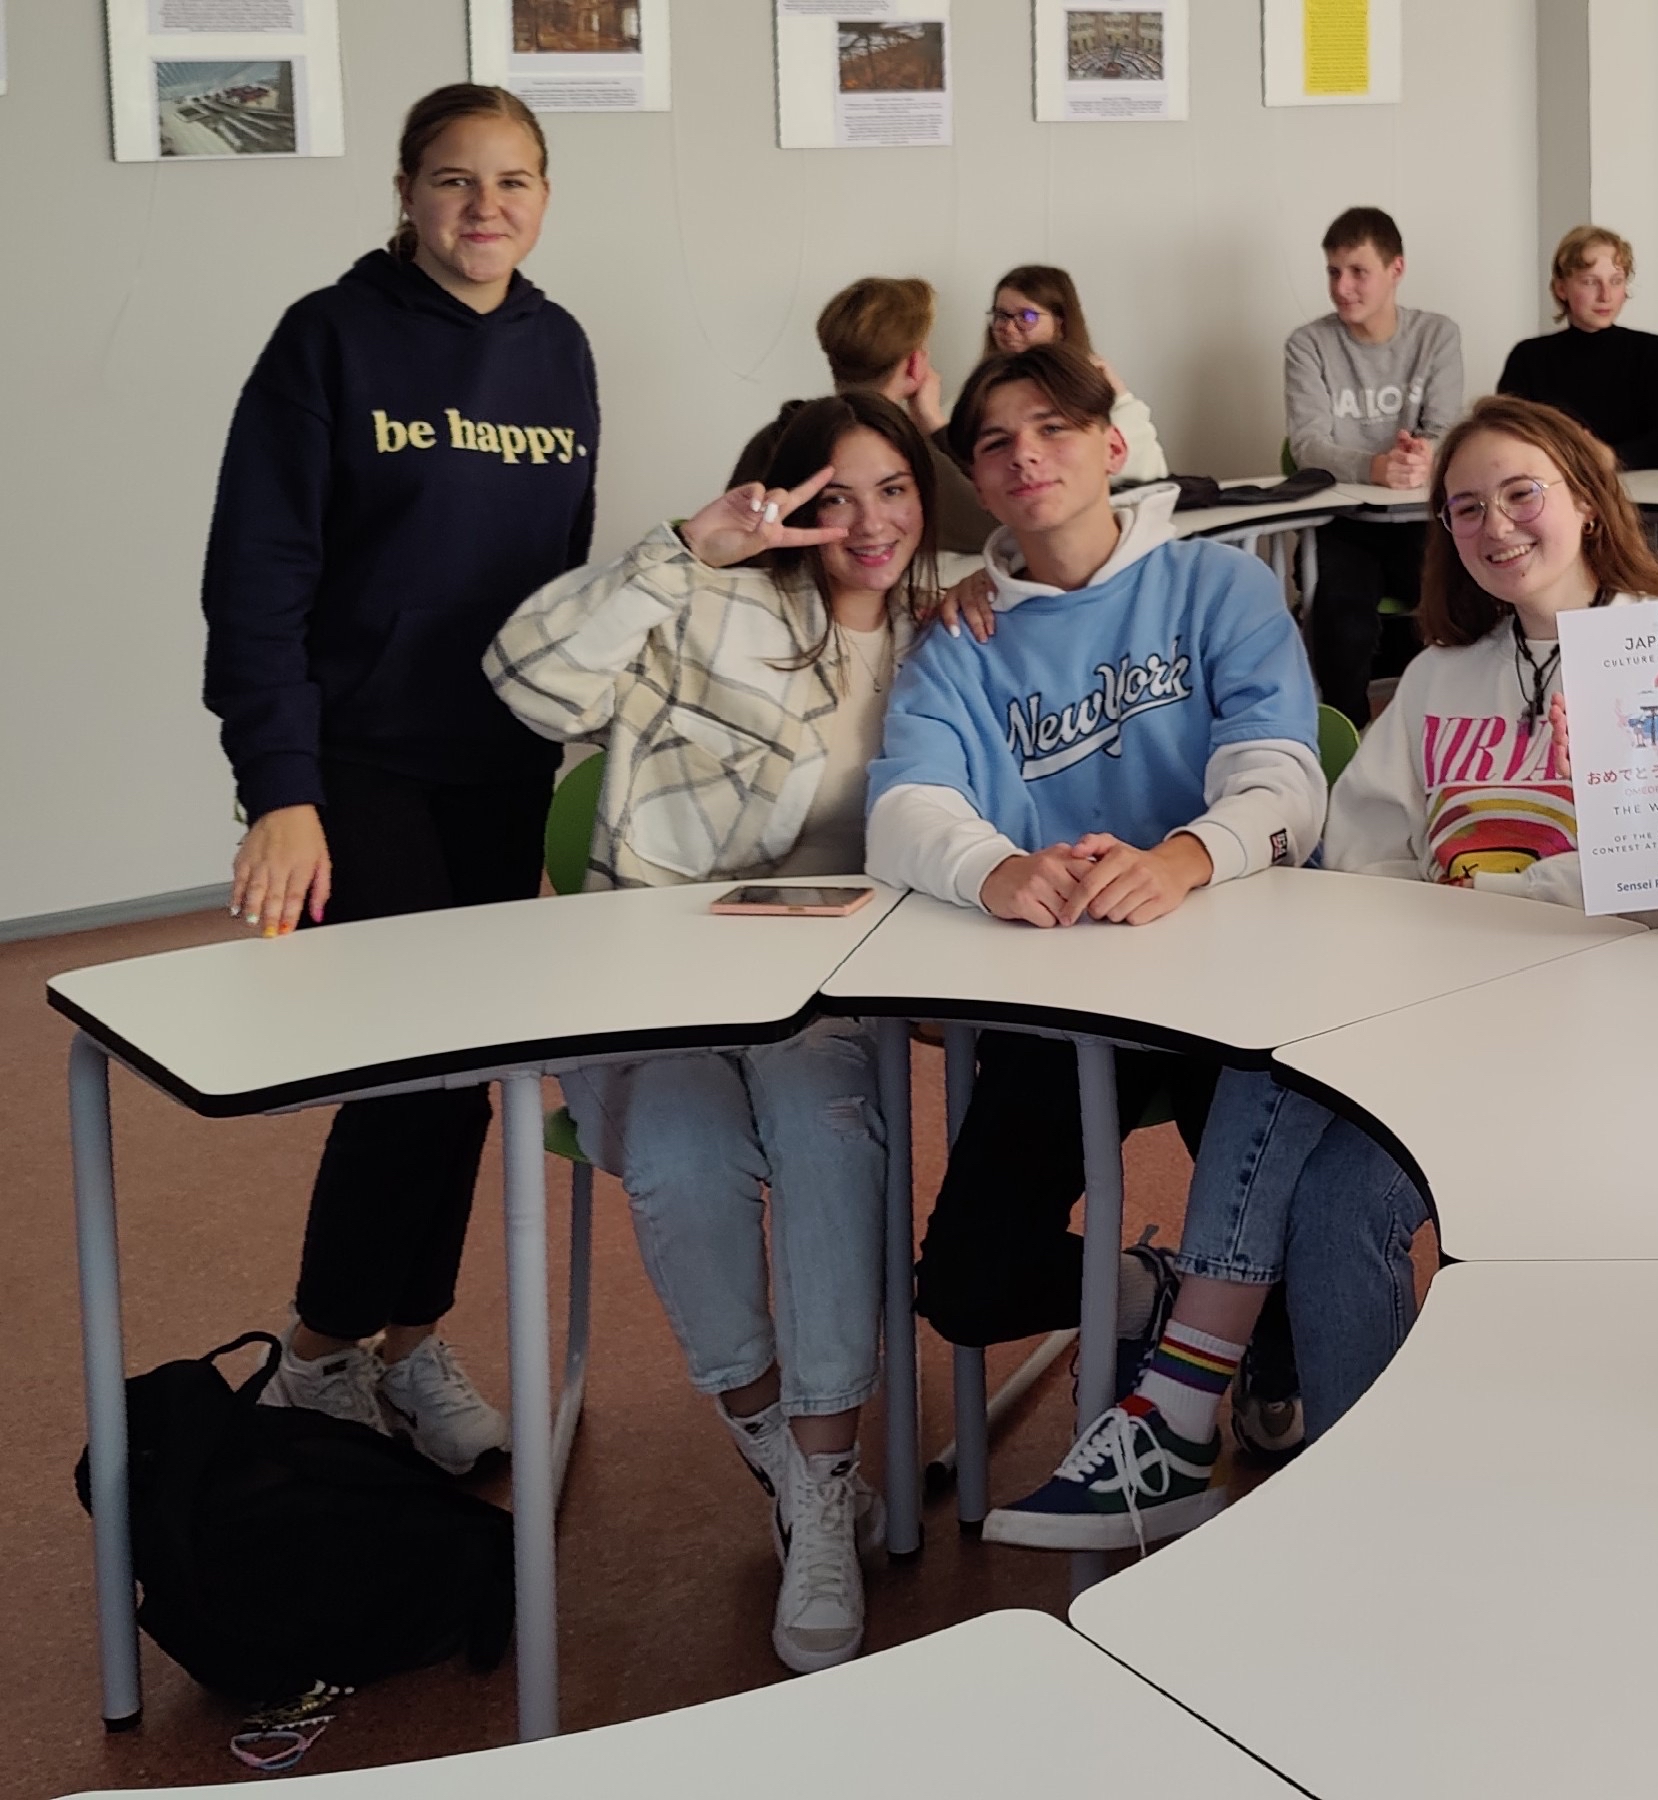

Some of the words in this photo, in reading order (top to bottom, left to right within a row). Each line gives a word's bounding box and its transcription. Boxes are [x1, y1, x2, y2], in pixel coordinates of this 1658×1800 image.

[371, 409, 437, 454] be
[443, 407, 588, 464] happy.
[1603, 654, 1655, 668] CULTURE
[1006, 691, 1104, 760] New
[1094, 634, 1193, 758] York
[1613, 805, 1642, 816] THE
[1614, 835, 1628, 843] OF
[1633, 832, 1652, 840] THE
[1592, 843, 1640, 856] CONTEST
[1617, 878, 1652, 892] Sensei
